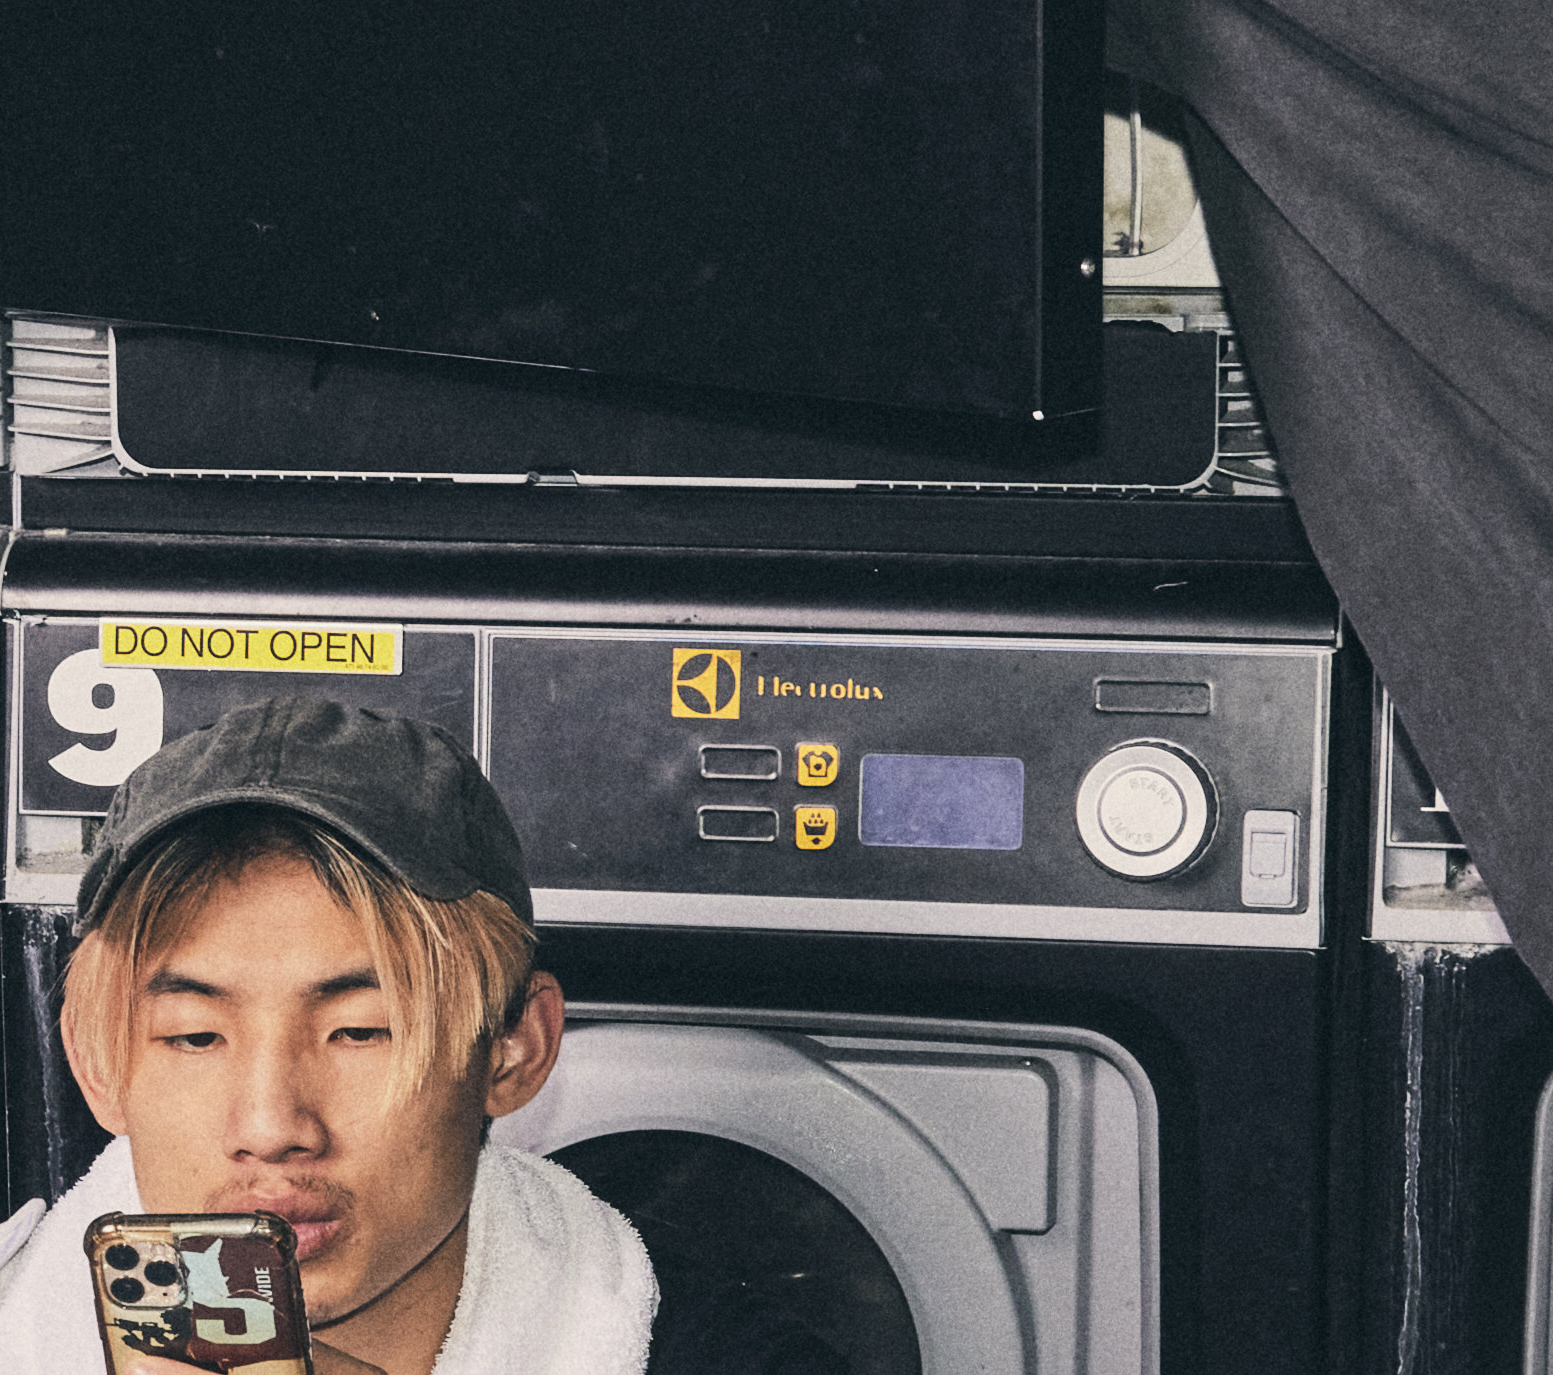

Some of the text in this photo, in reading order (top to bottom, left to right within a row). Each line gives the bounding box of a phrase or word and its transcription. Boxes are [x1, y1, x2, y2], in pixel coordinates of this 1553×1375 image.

[115, 625, 374, 663] DO NOT OPEN
[47, 647, 164, 787] 9
[1129, 777, 1174, 807] START
